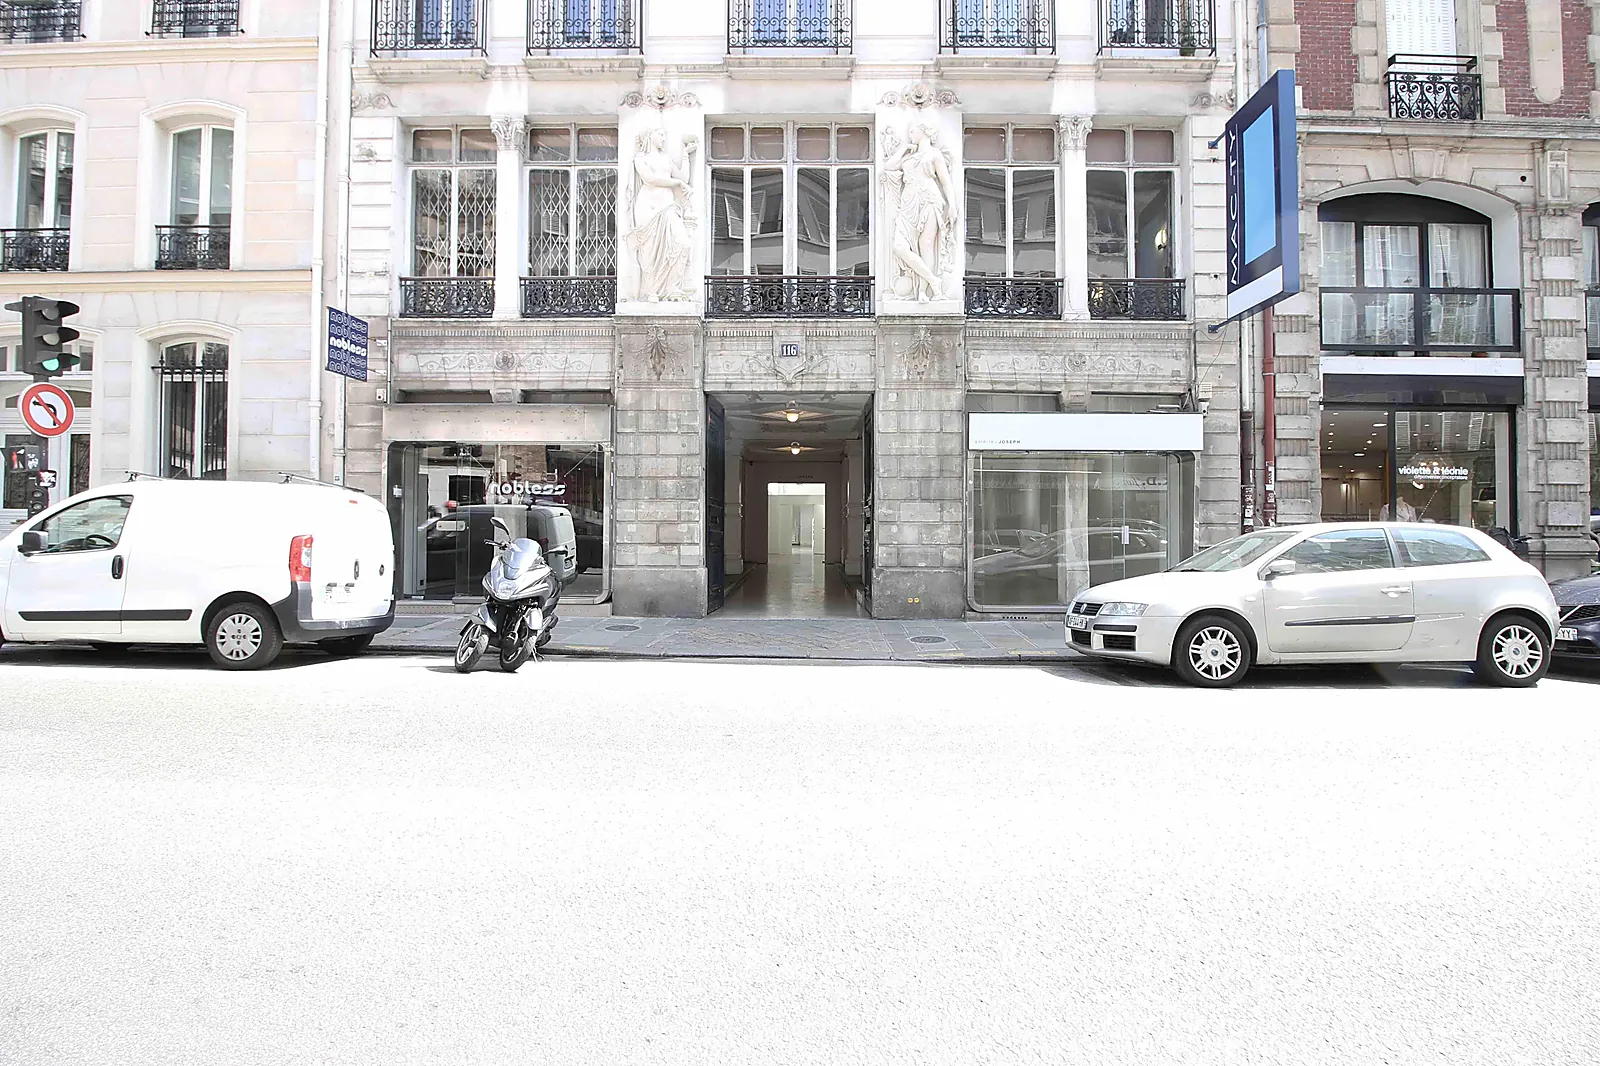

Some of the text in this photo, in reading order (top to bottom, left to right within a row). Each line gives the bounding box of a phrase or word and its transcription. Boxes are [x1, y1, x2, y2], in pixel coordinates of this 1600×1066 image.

[330, 312, 367, 333] nobless
[330, 324, 367, 345] nobless
[329, 336, 367, 357] nobless
[782, 345, 797, 356] 116
[329, 348, 367, 368] nobless
[328, 361, 367, 380] nobless
[1398, 466, 1469, 476] violette & léonie
[490, 480, 566, 495] nobless
